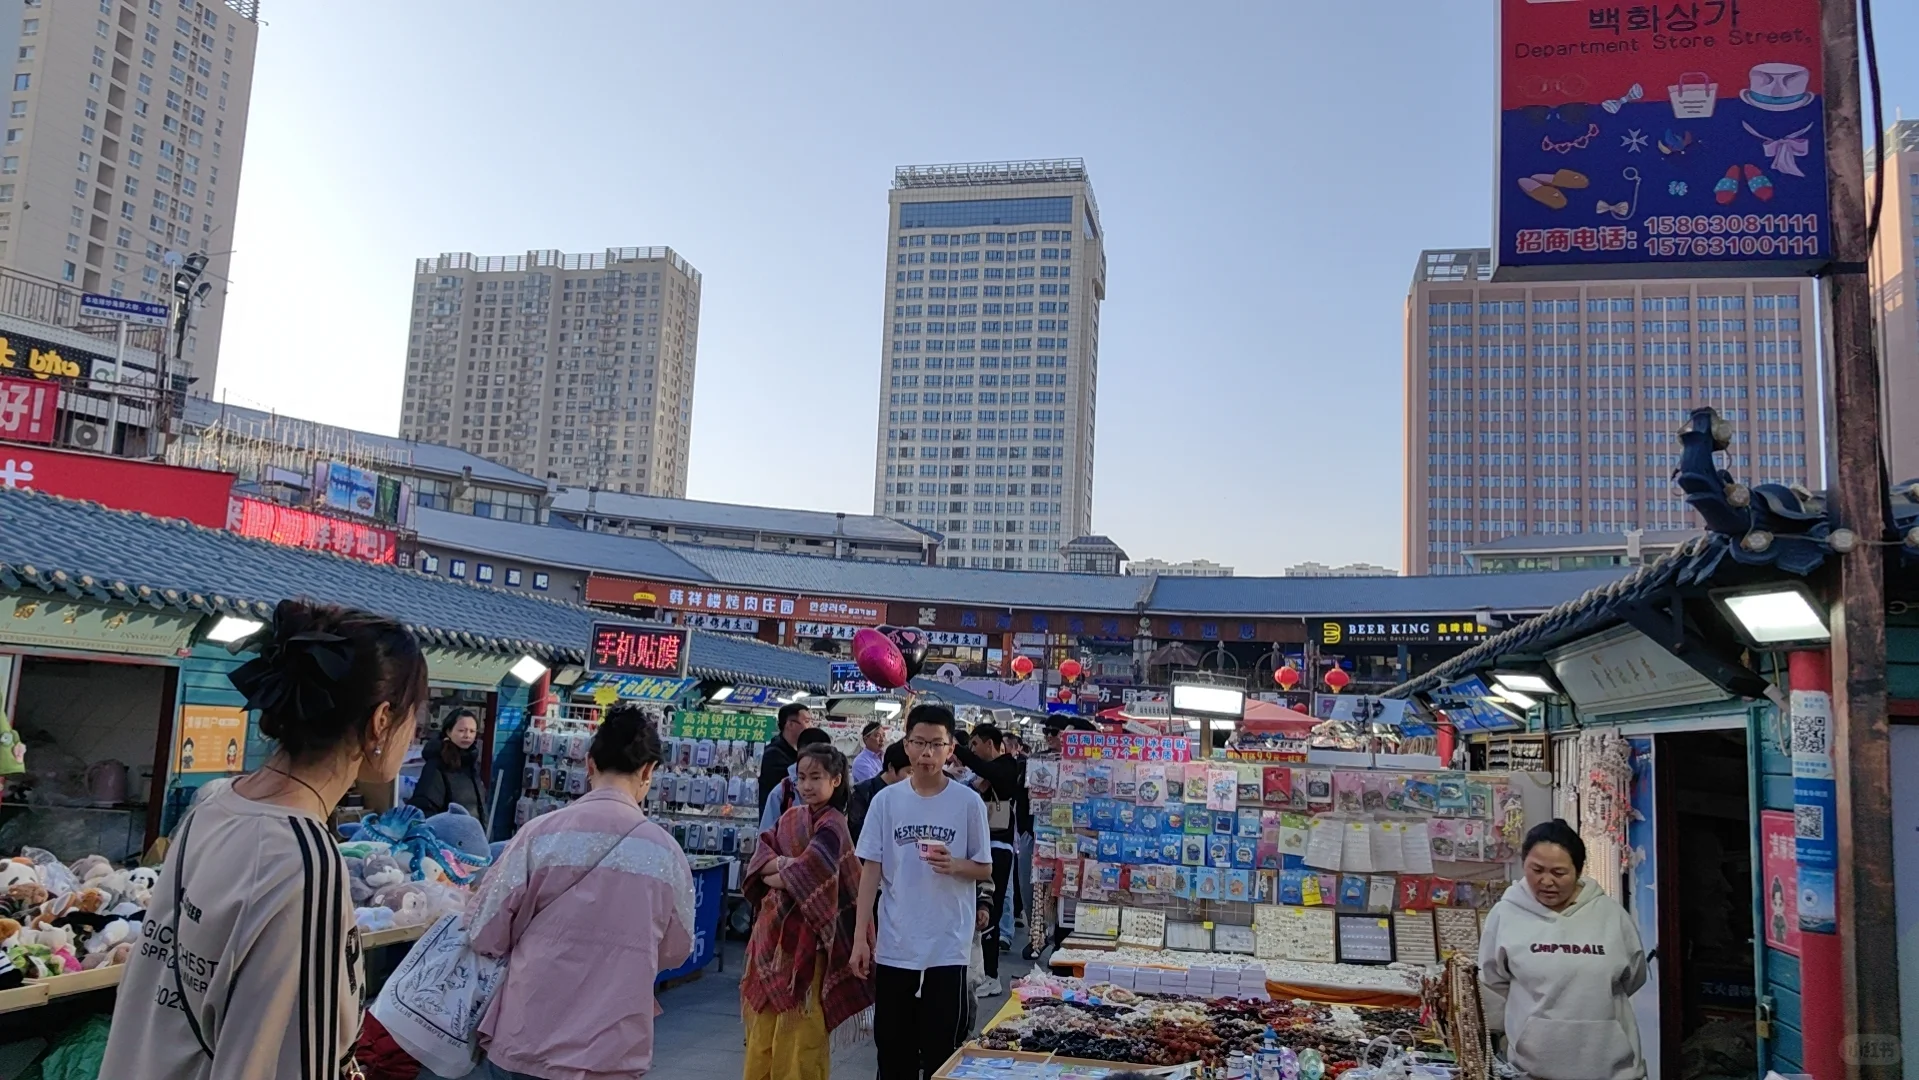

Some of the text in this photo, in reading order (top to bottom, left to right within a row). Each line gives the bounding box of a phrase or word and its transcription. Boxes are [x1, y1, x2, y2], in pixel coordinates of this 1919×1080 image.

[1589, 0, 1740, 35] 백화상가
[1514, 38, 1640, 59] Department
[1652, 34, 1716, 50] Store
[1644, 213, 1818, 236] 15863081111
[1644, 236, 1819, 257] 15763100111
[668, 588, 795, 616] 韩祥楼烤肉庄园
[1348, 623, 1431, 635] BEER KING
[595, 630, 681, 671] 手机贴膜
[832, 680, 887, 693] 小红书推
[683, 711, 768, 728] 高清钢化10元
[680, 724, 766, 741] 室内空调开放
